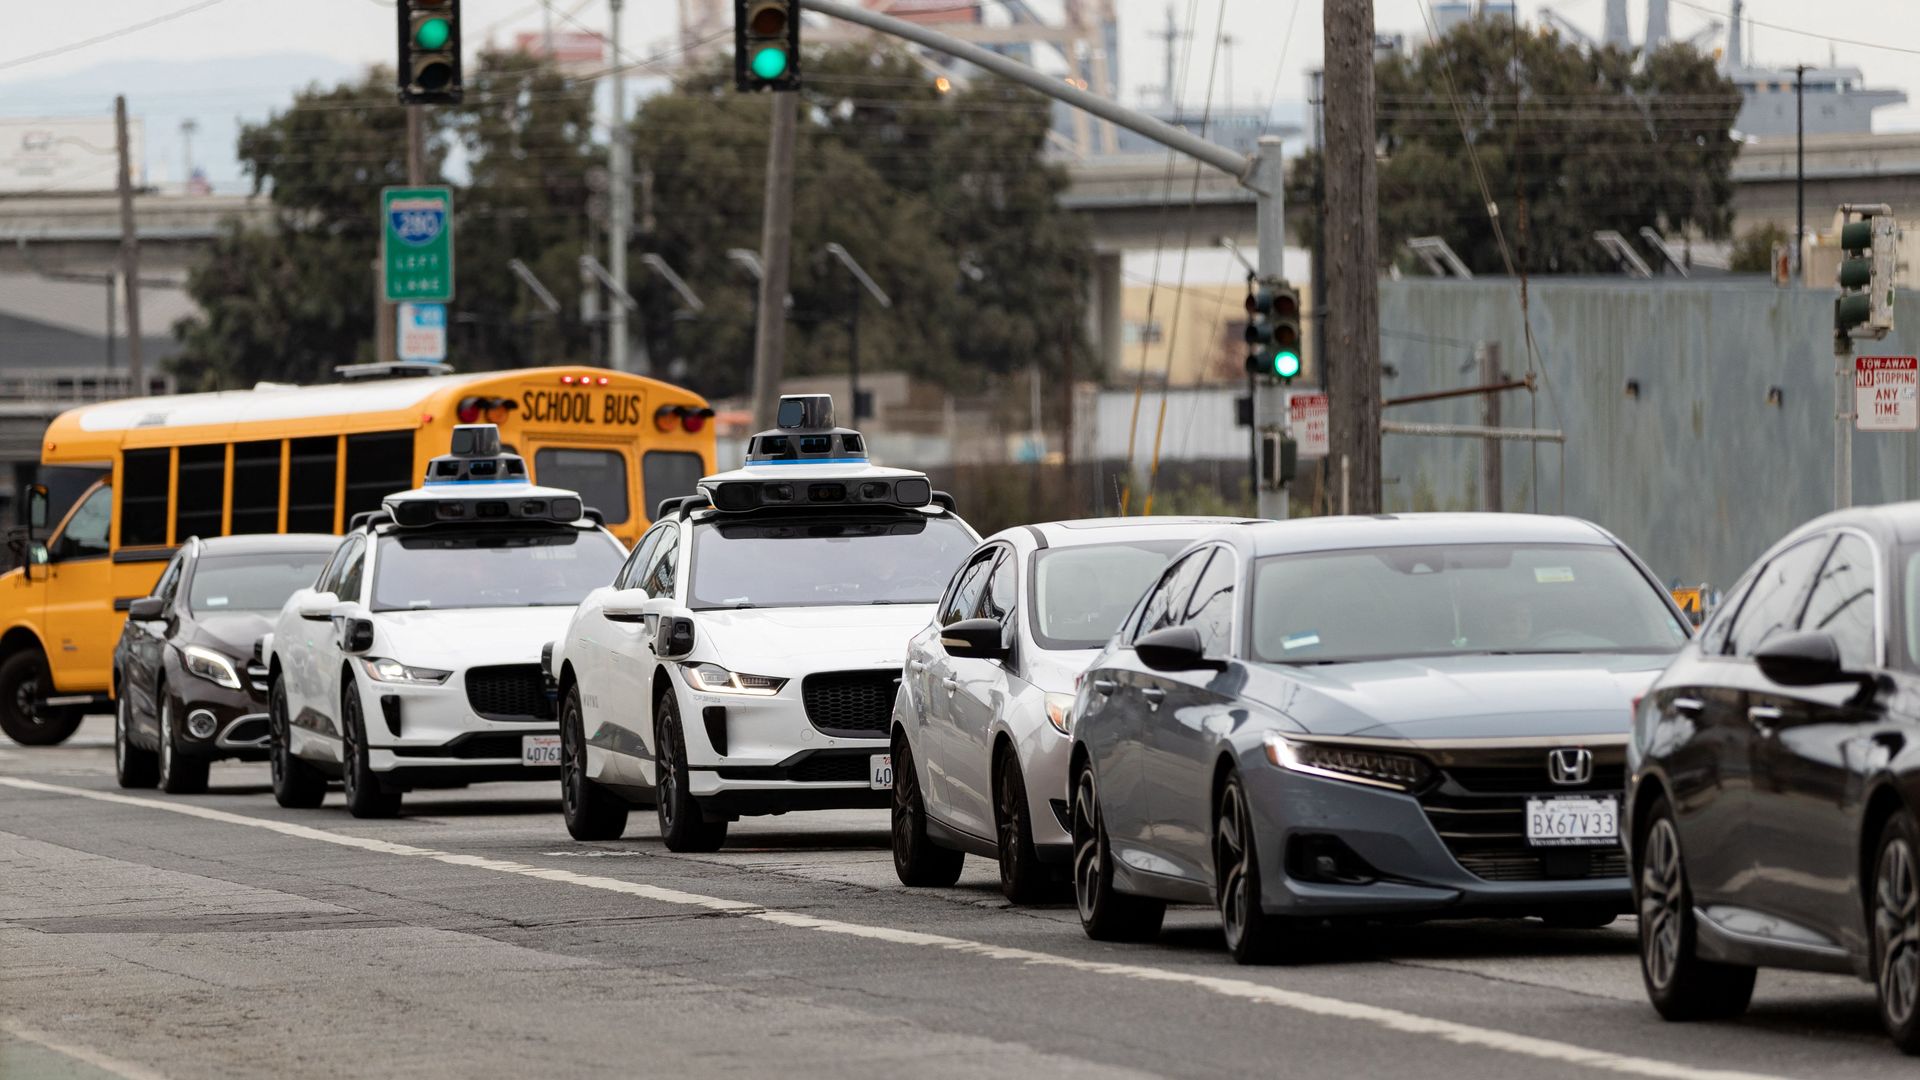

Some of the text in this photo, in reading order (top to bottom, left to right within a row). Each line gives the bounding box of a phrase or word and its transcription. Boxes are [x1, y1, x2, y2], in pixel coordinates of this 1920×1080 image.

[399, 212, 437, 234] 280
[395, 253, 438, 270] LEFT
[1861, 358, 1912, 369] TOW-AWAY
[1857, 370, 1915, 386] NO STOPPING
[1875, 388, 1898, 400] ANY
[522, 390, 640, 425] SCHOOL BUS
[1875, 402, 1900, 415] TIME
[875, 768, 892, 784] 40
[1533, 813, 1613, 835] BX67V33
